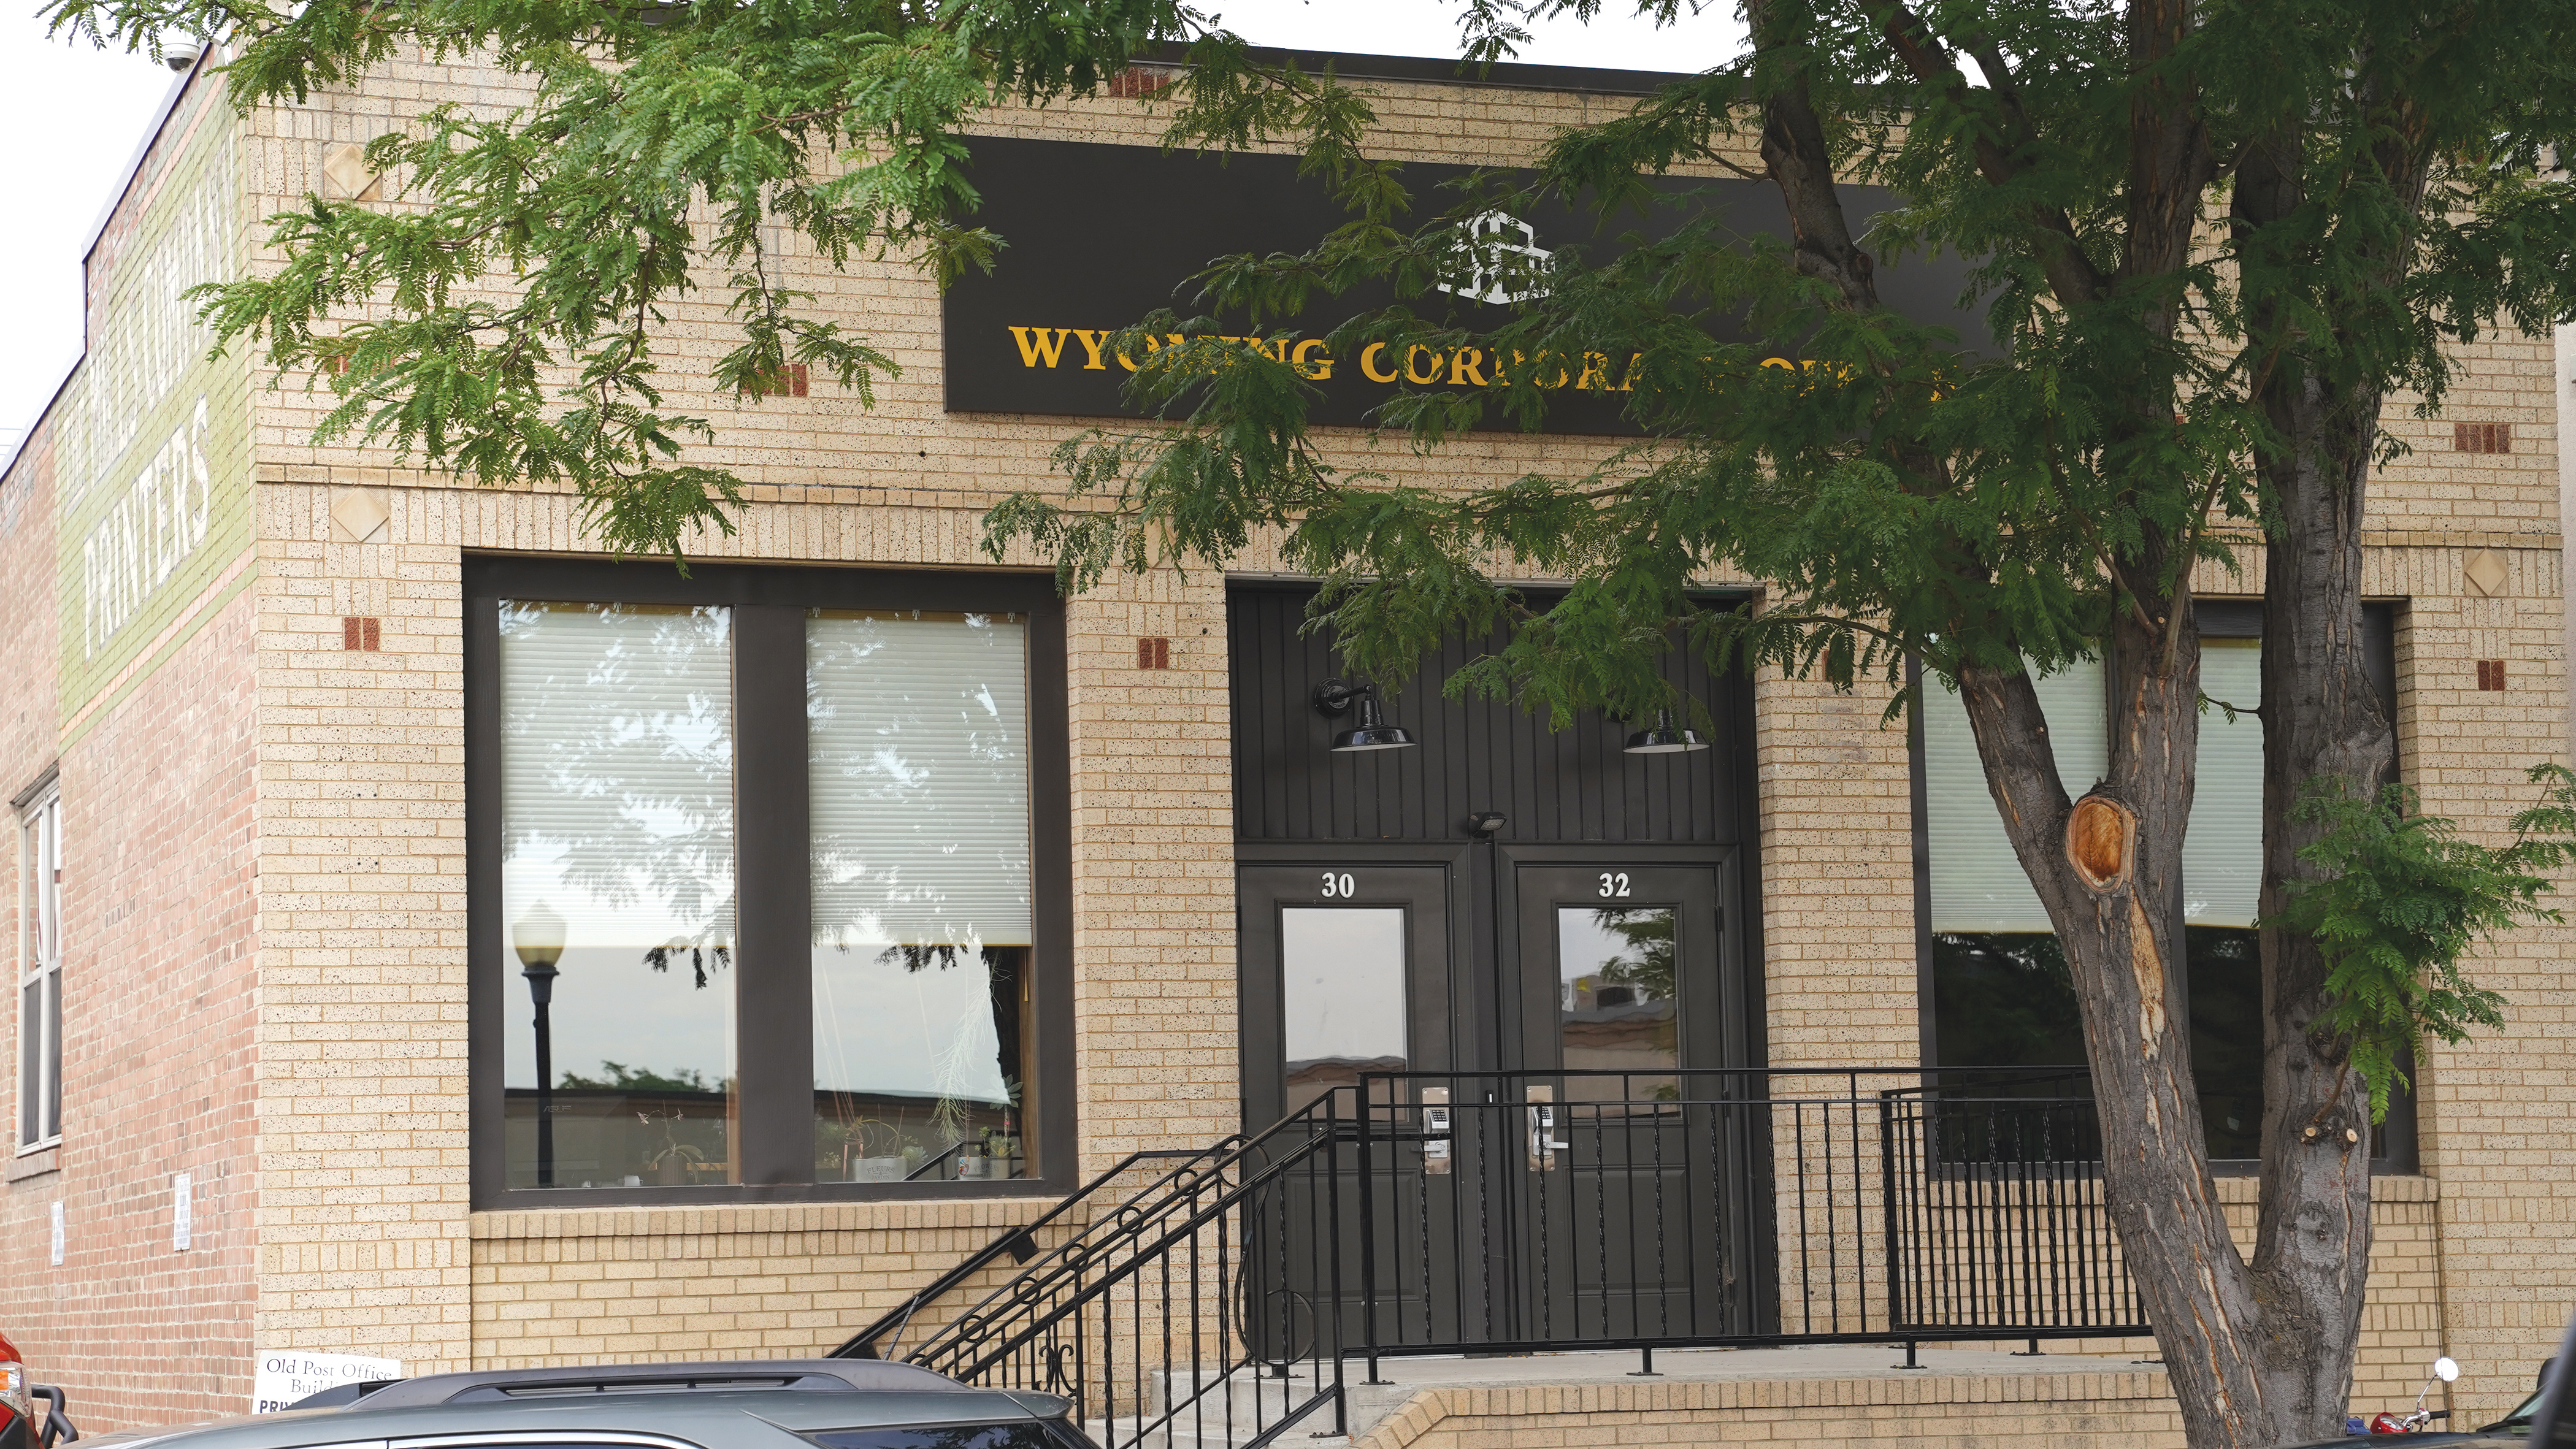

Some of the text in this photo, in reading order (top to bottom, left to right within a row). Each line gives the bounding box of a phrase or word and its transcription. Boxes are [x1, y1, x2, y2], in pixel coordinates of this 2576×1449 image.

[82, 393, 210, 661] PRINTERS
[1321, 872, 1355, 898] 30
[1598, 873, 1630, 898] 32
[267, 1358, 392, 1381] Old Post Office
